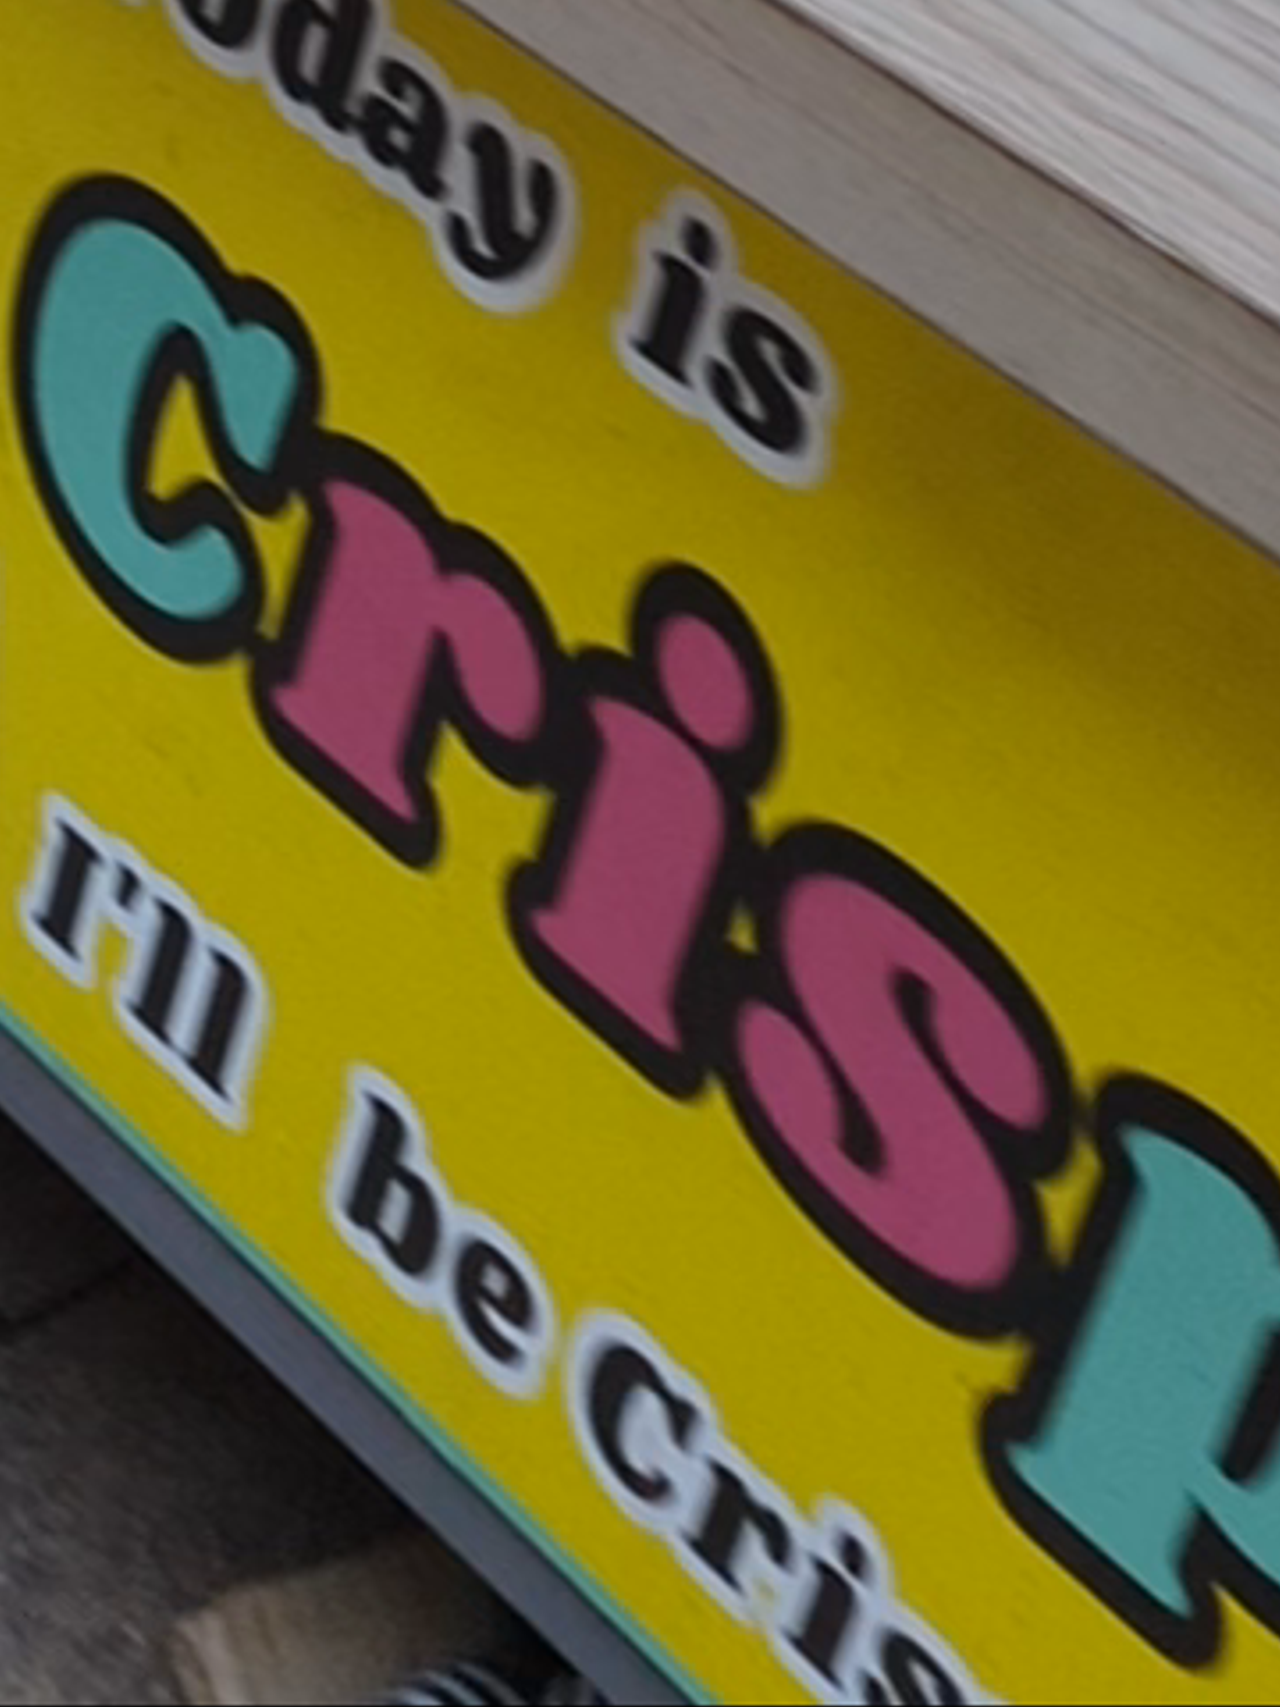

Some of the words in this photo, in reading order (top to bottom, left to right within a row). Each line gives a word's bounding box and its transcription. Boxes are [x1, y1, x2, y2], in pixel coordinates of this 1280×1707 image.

[628, 216, 819, 456] is
[30, 815, 252, 1104] I'll
[342, 1088, 536, 1367] be
